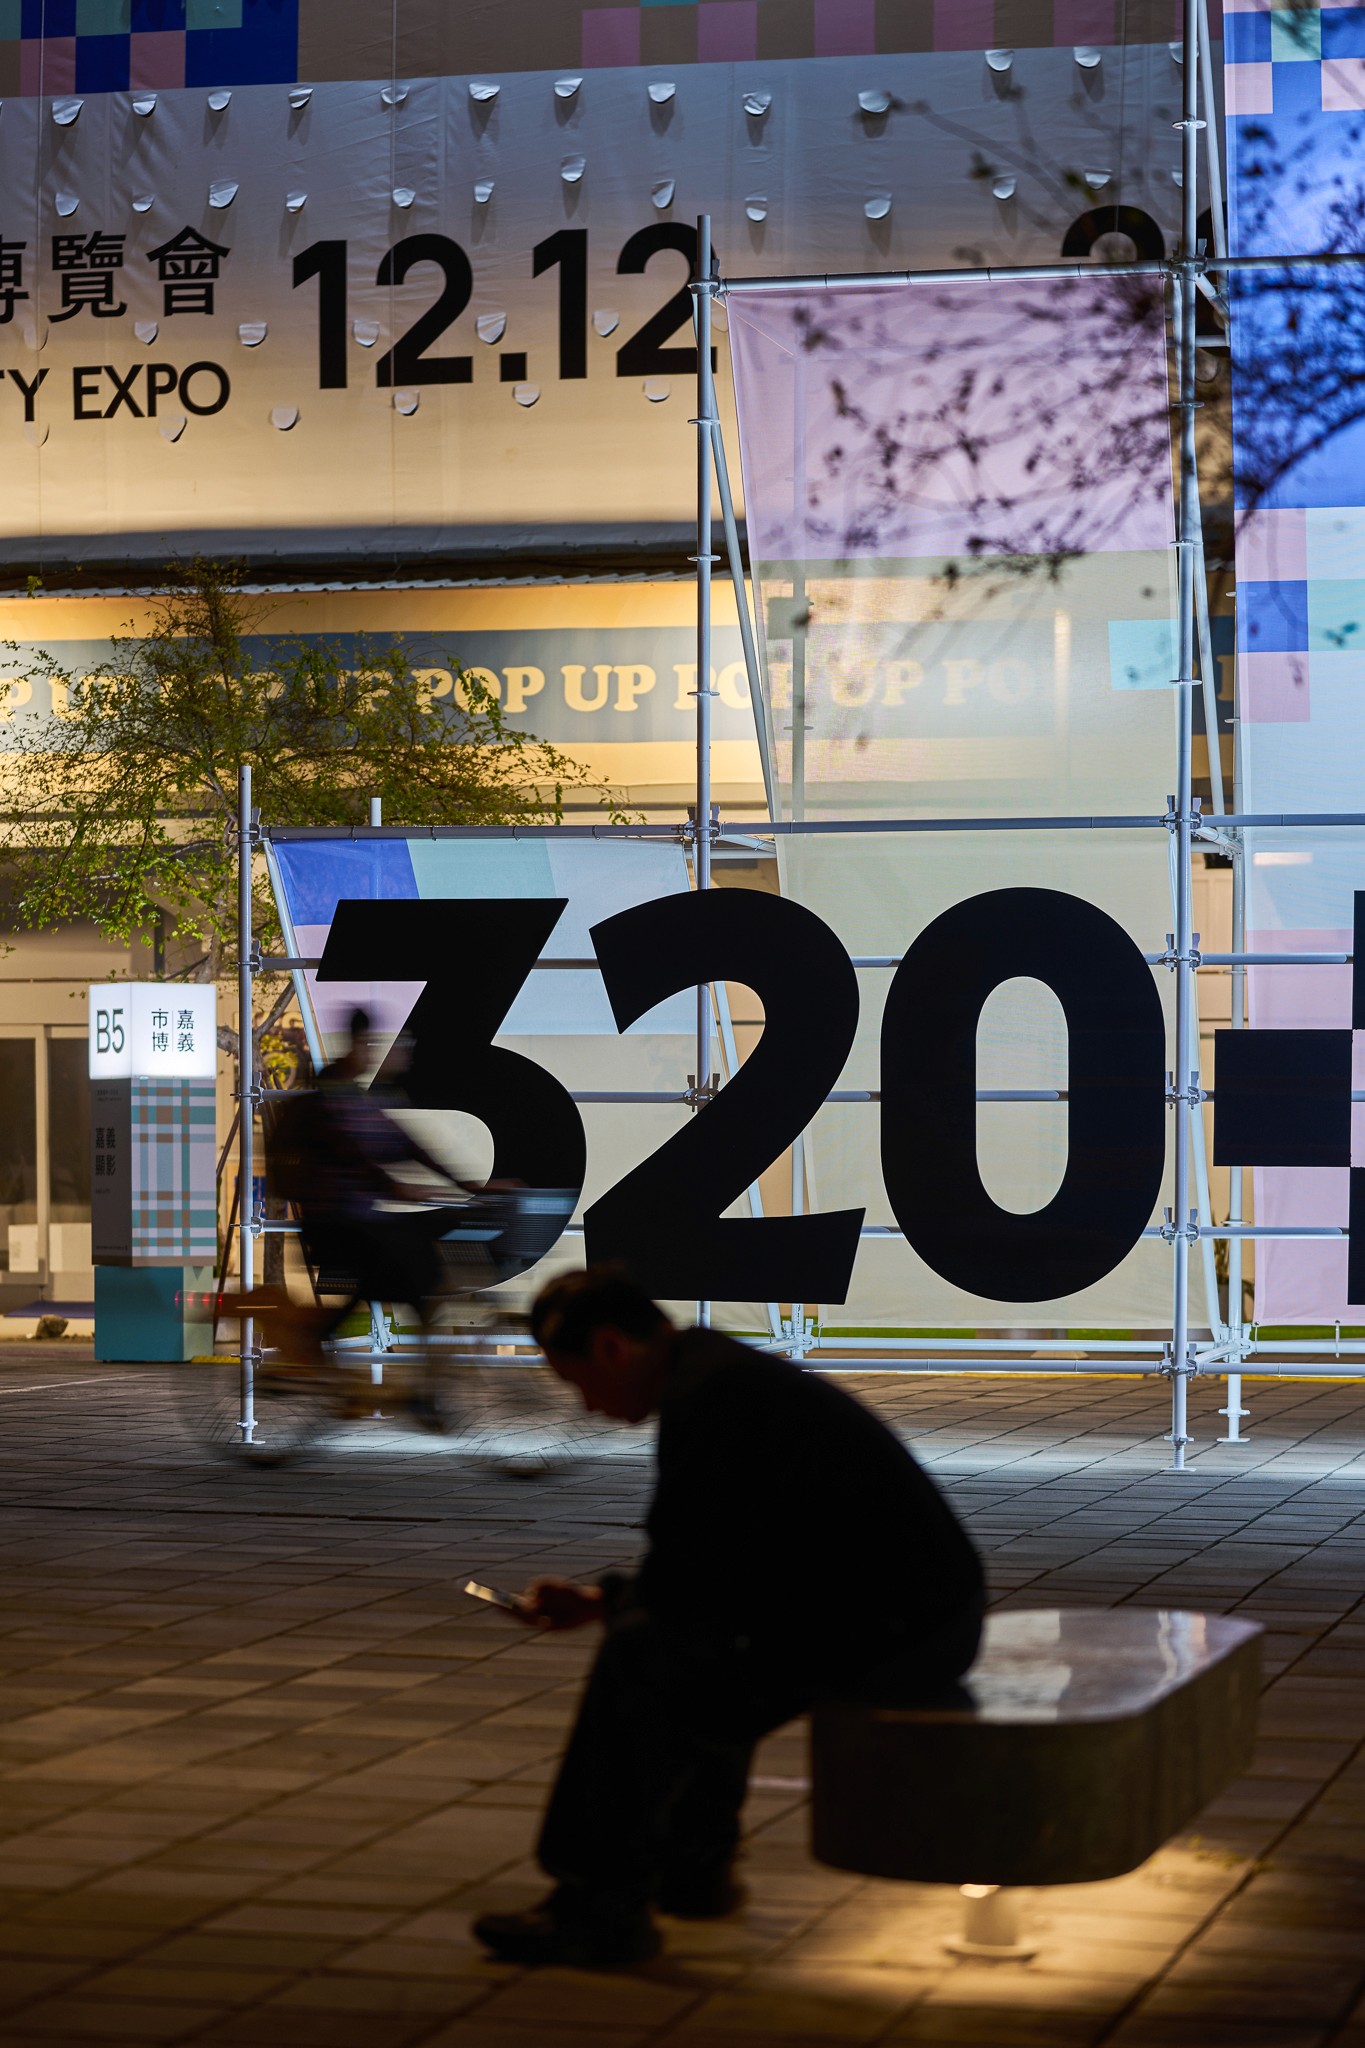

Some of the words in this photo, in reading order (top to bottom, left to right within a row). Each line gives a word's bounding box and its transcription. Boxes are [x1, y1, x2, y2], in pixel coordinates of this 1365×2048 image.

[292, 222, 717, 389] 12.12
[0, 367, 50, 422] Y
[73, 360, 231, 420] EXPO
[411, 666, 545, 714] POP
[561, 664, 656, 712] UP
[829, 658, 924, 707] UP
[97, 1008, 125, 1053] B5
[151, 1008, 169, 1052] 市博
[177, 1009, 195, 1052] 嘉義
